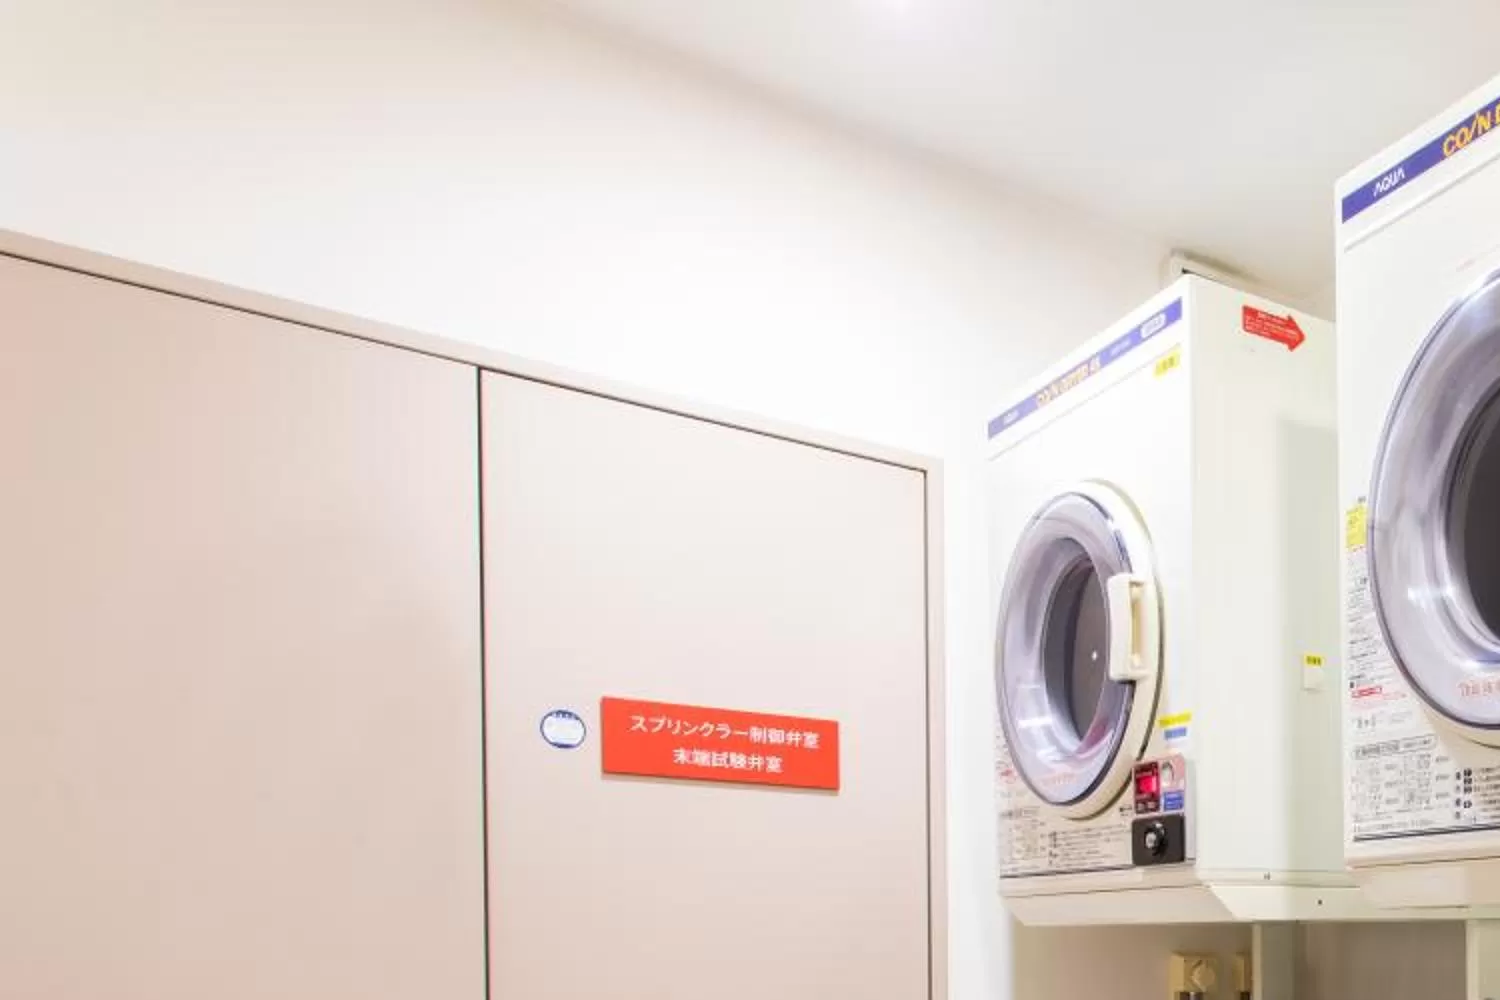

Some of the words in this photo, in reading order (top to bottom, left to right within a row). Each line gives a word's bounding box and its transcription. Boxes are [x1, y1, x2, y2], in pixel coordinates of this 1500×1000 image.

[1372, 167, 1405, 197] AQUA
[1443, 110, 1491, 158] COIN
[630, 714, 821, 750] スプリンクラー制御弁室
[672, 747, 784, 774] 末端試験弁室
